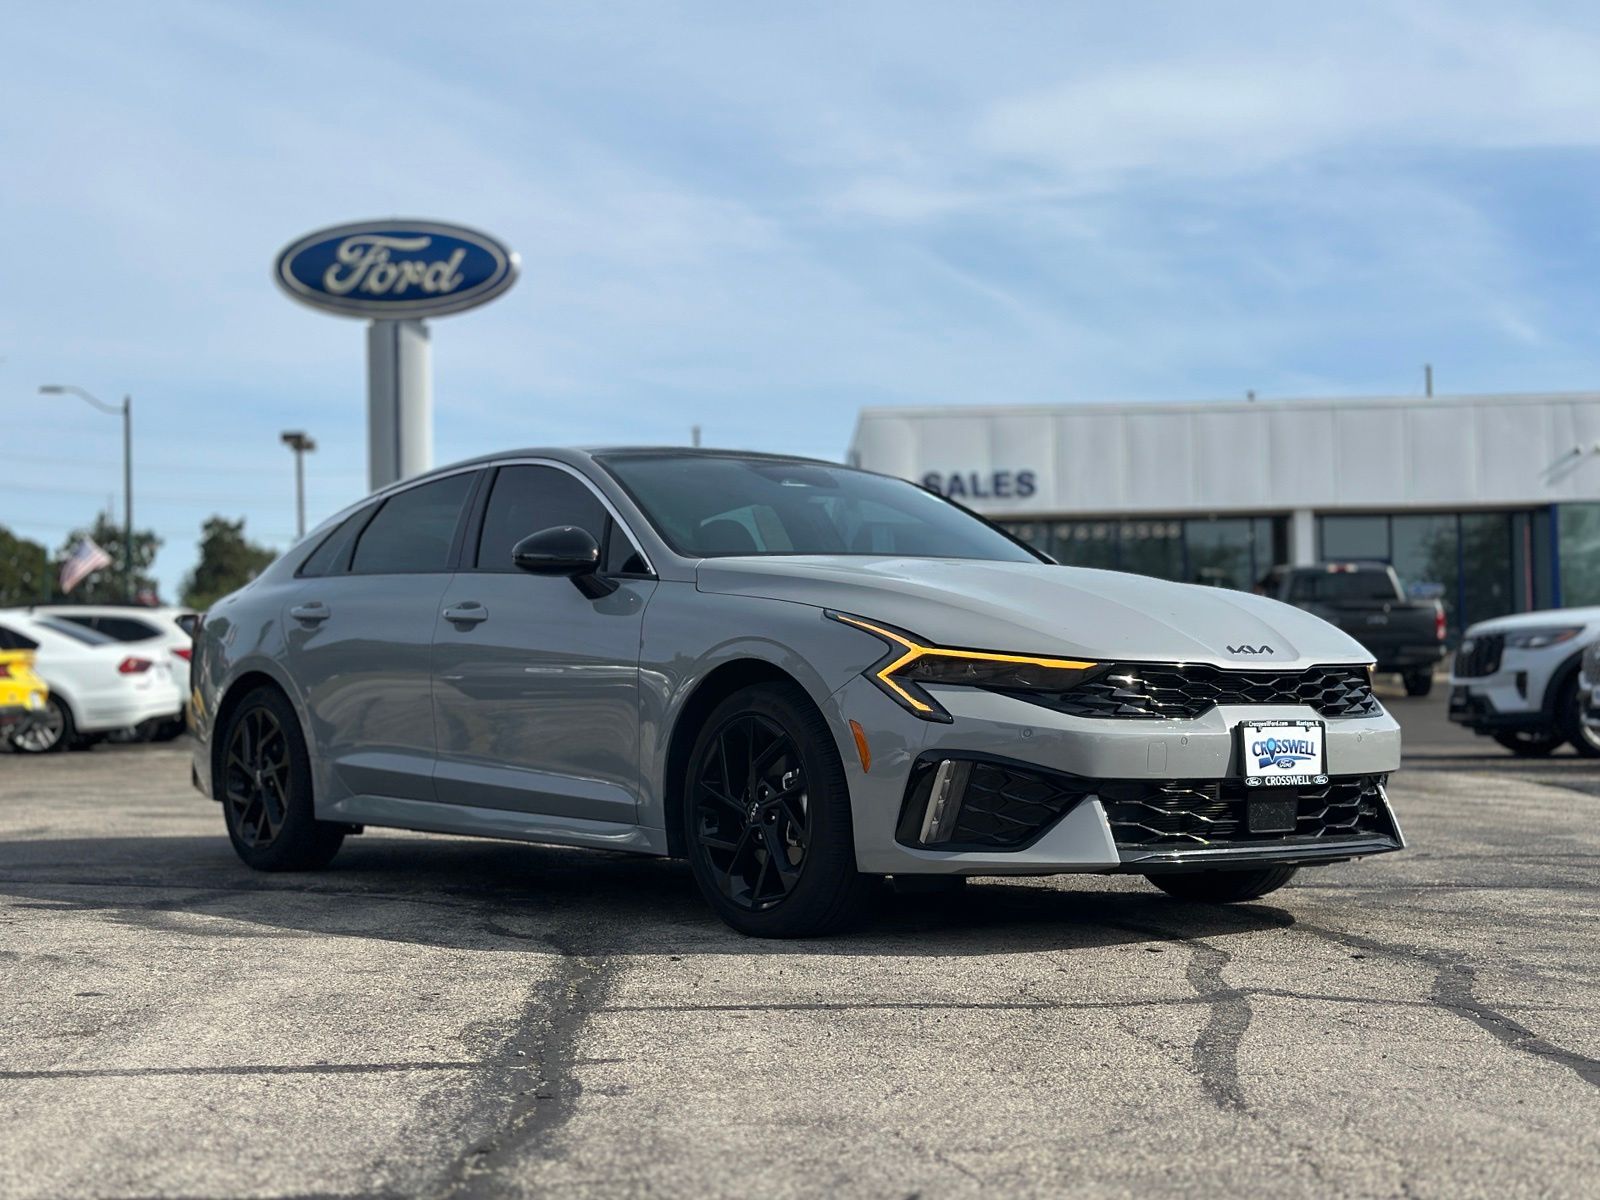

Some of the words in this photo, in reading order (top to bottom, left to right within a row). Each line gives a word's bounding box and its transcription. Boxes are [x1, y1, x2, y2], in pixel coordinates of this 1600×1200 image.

[323, 234, 466, 295] Ford
[922, 470, 1037, 498] SALES
[1252, 738, 1316, 757] CROSSWELL
[1279, 760, 1293, 768] Ford
[1265, 775, 1311, 786] CROSSWELL
